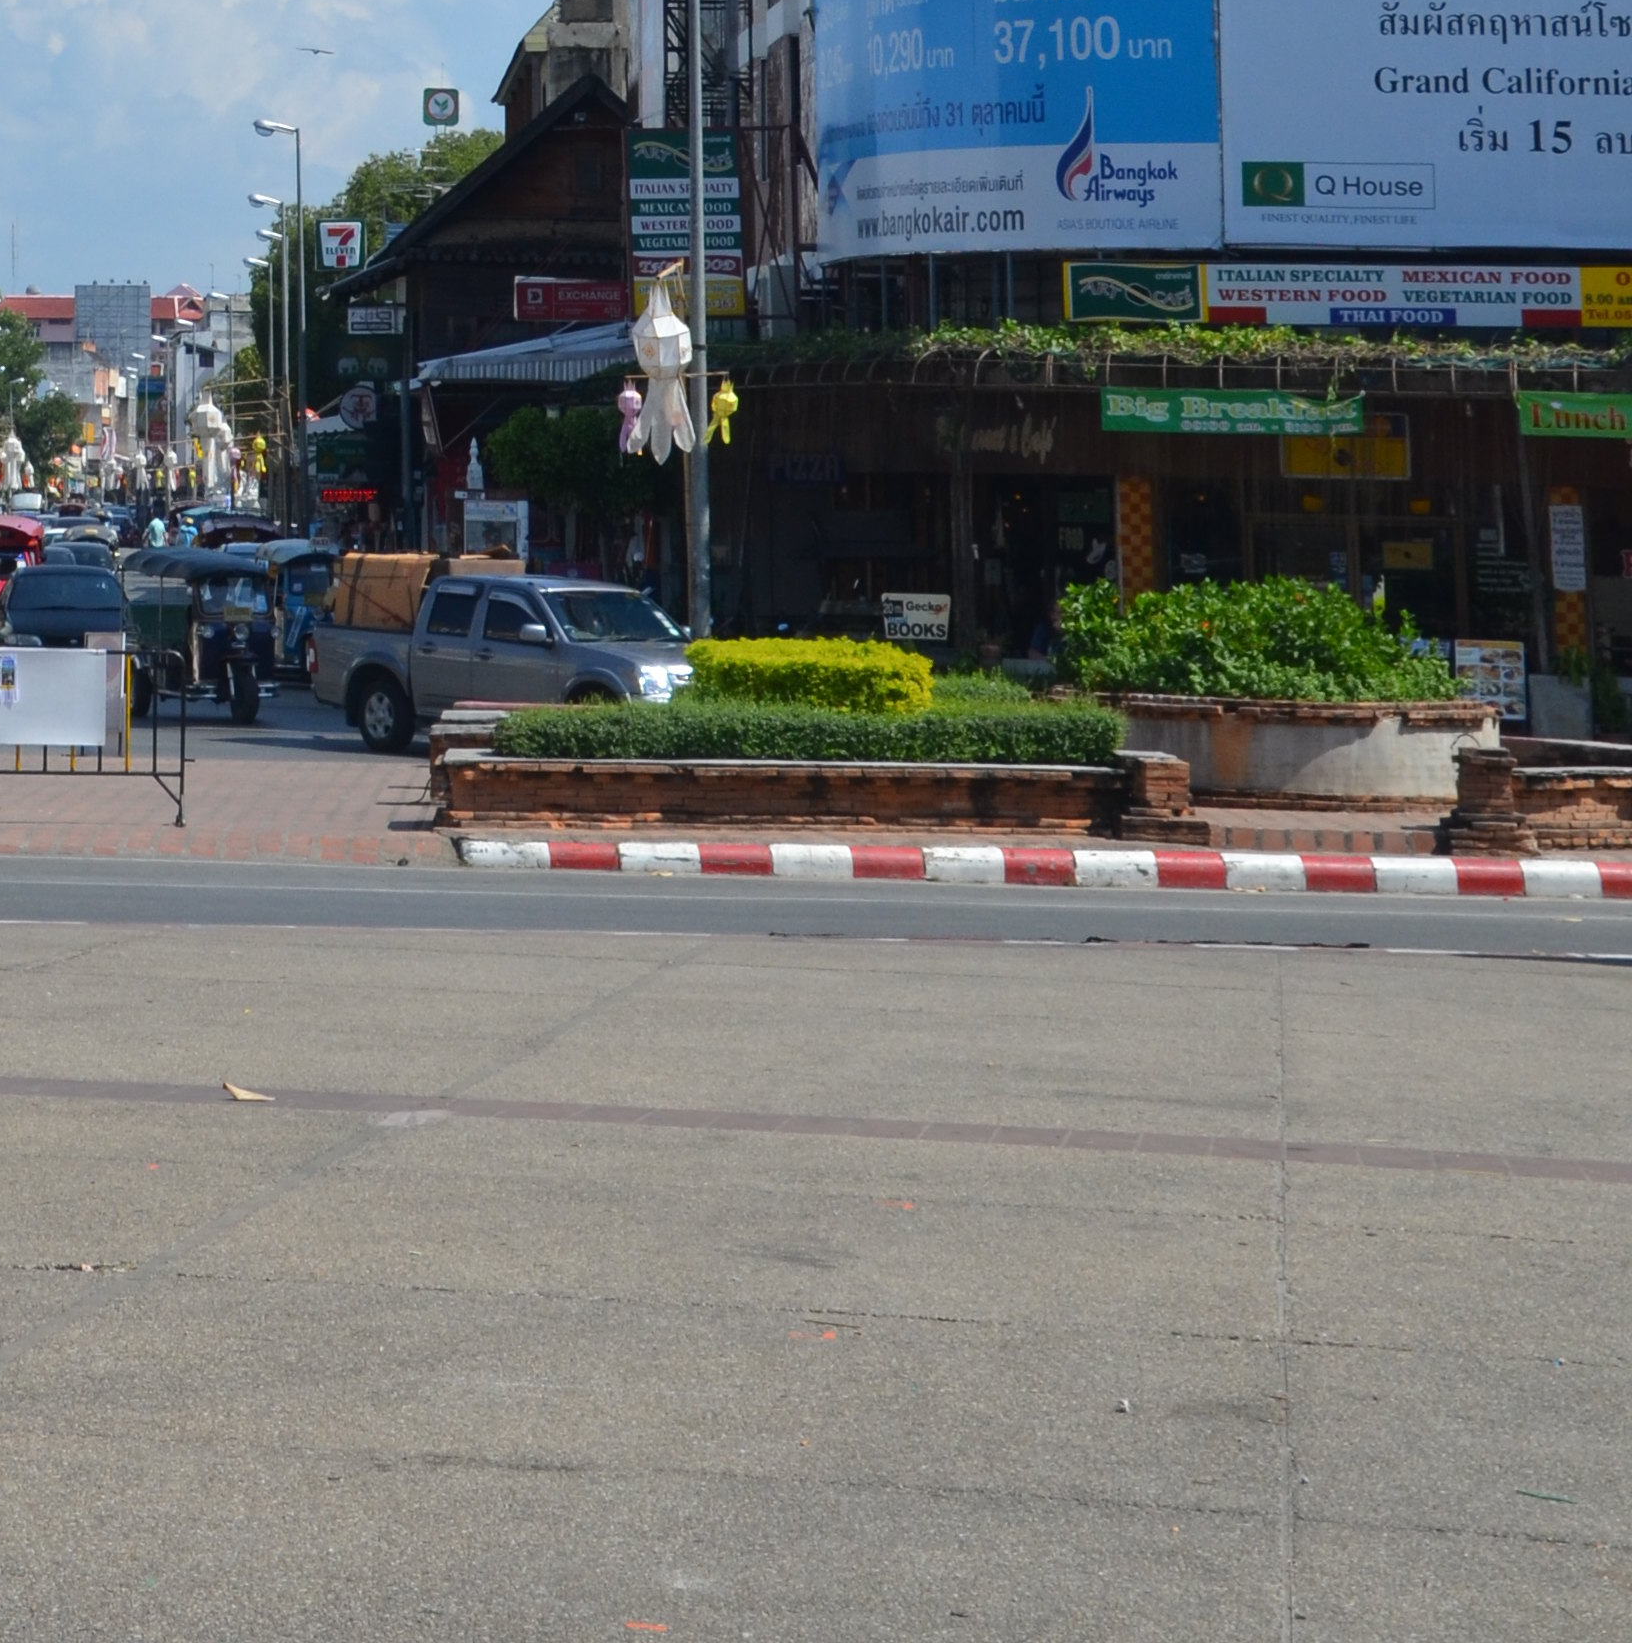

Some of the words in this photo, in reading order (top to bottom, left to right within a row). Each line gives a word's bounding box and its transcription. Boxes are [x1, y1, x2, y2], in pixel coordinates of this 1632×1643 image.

[993, 15, 1120, 70] 37,100
[1128, 37, 1172, 59] บาท
[867, 28, 923, 82] 10,290
[927, 47, 954, 68] บาท
[1374, 66, 1469, 94] Grand
[945, 102, 965, 126] 31
[971, 83, 1045, 136] ตุลาคมนี้
[1458, 105, 1508, 152] เริ่ม
[1528, 119, 1573, 155] 15
[1099, 153, 1178, 187] Bangkok
[634, 182, 676, 195] ITALIAN
[1083, 173, 1156, 208] Airways
[1314, 175, 1336, 196] Q
[1343, 176, 1423, 197] House
[703, 201, 732, 212] OOD
[640, 219, 689, 231] WESTER
[706, 219, 734, 230] OOD
[856, 206, 1025, 243] www.bangkokair.com
[1261, 214, 1300, 223] FINEST
[639, 237, 691, 248] VEGETARI
[706, 236, 735, 247] FOOD
[703, 259, 737, 272] OOD
[1217, 269, 1285, 283] ITALIAN
[1290, 269, 1384, 283] SPECIALTY
[1402, 270, 1502, 285] MEXICAN
[1510, 271, 1572, 286] FOOD
[558, 290, 621, 300] EXCHANGE
[1219, 289, 1321, 303] WESTERN
[1327, 290, 1387, 303] FOOD
[1403, 290, 1517, 304] VEGETARIAN
[1522, 291, 1572, 305] FOOD
[1340, 310, 1386, 323] THAI
[1390, 310, 1444, 323] FOOD
[1106, 395, 1169, 422] Big
[1180, 396, 1357, 421] Breakfast
[1531, 402, 1627, 431] Lunch
[887, 622, 946, 638] BOOKS
